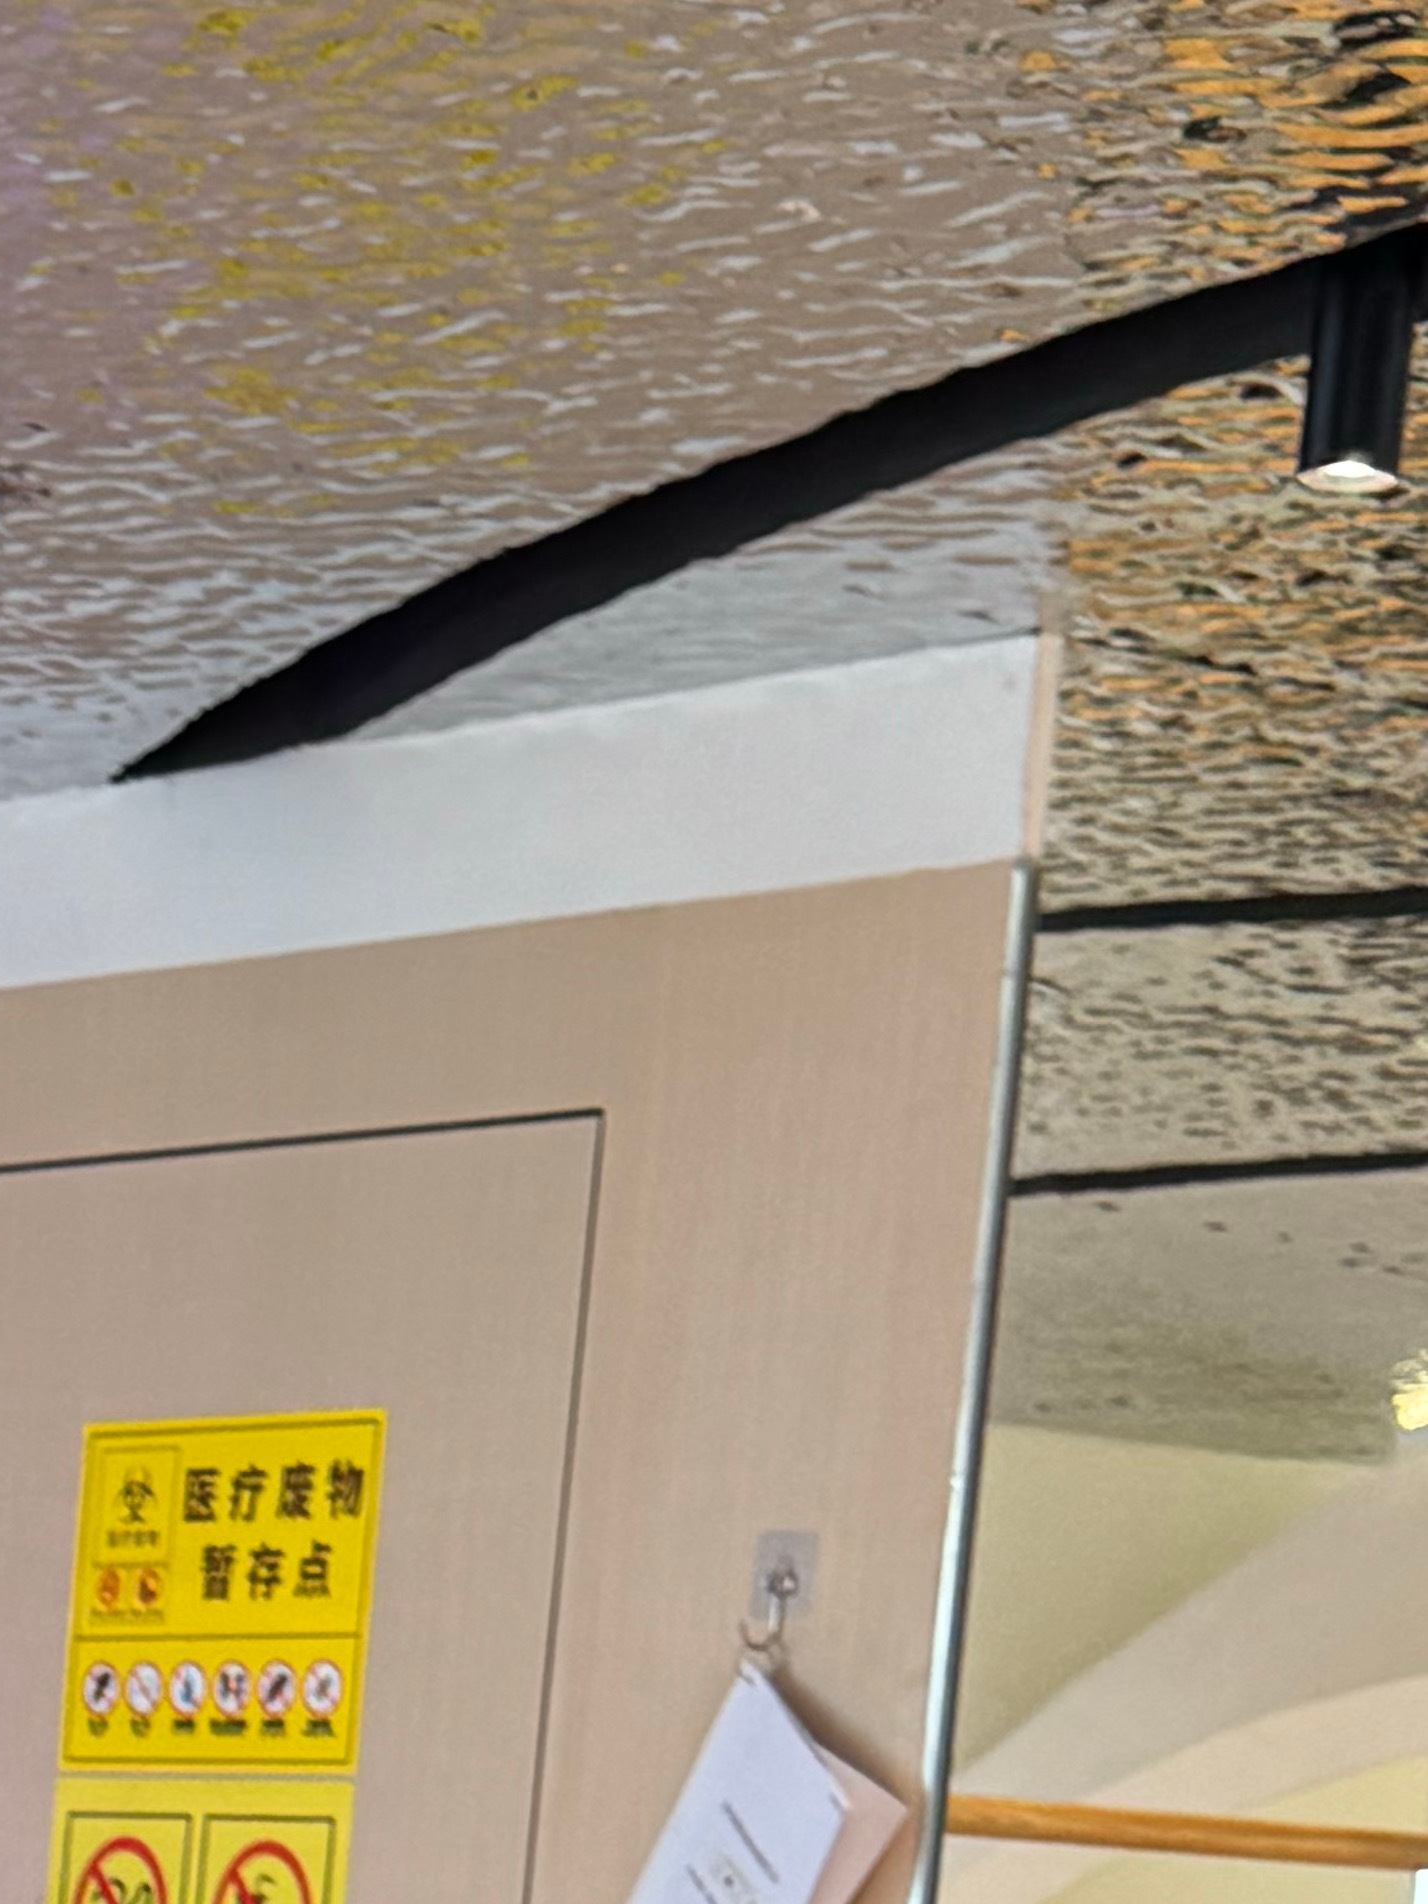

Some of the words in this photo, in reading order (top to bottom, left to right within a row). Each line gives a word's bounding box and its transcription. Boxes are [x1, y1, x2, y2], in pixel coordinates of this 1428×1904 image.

[183, 1459, 364, 1523] 医疗废物
[200, 1540, 332, 1600] 暂存点
